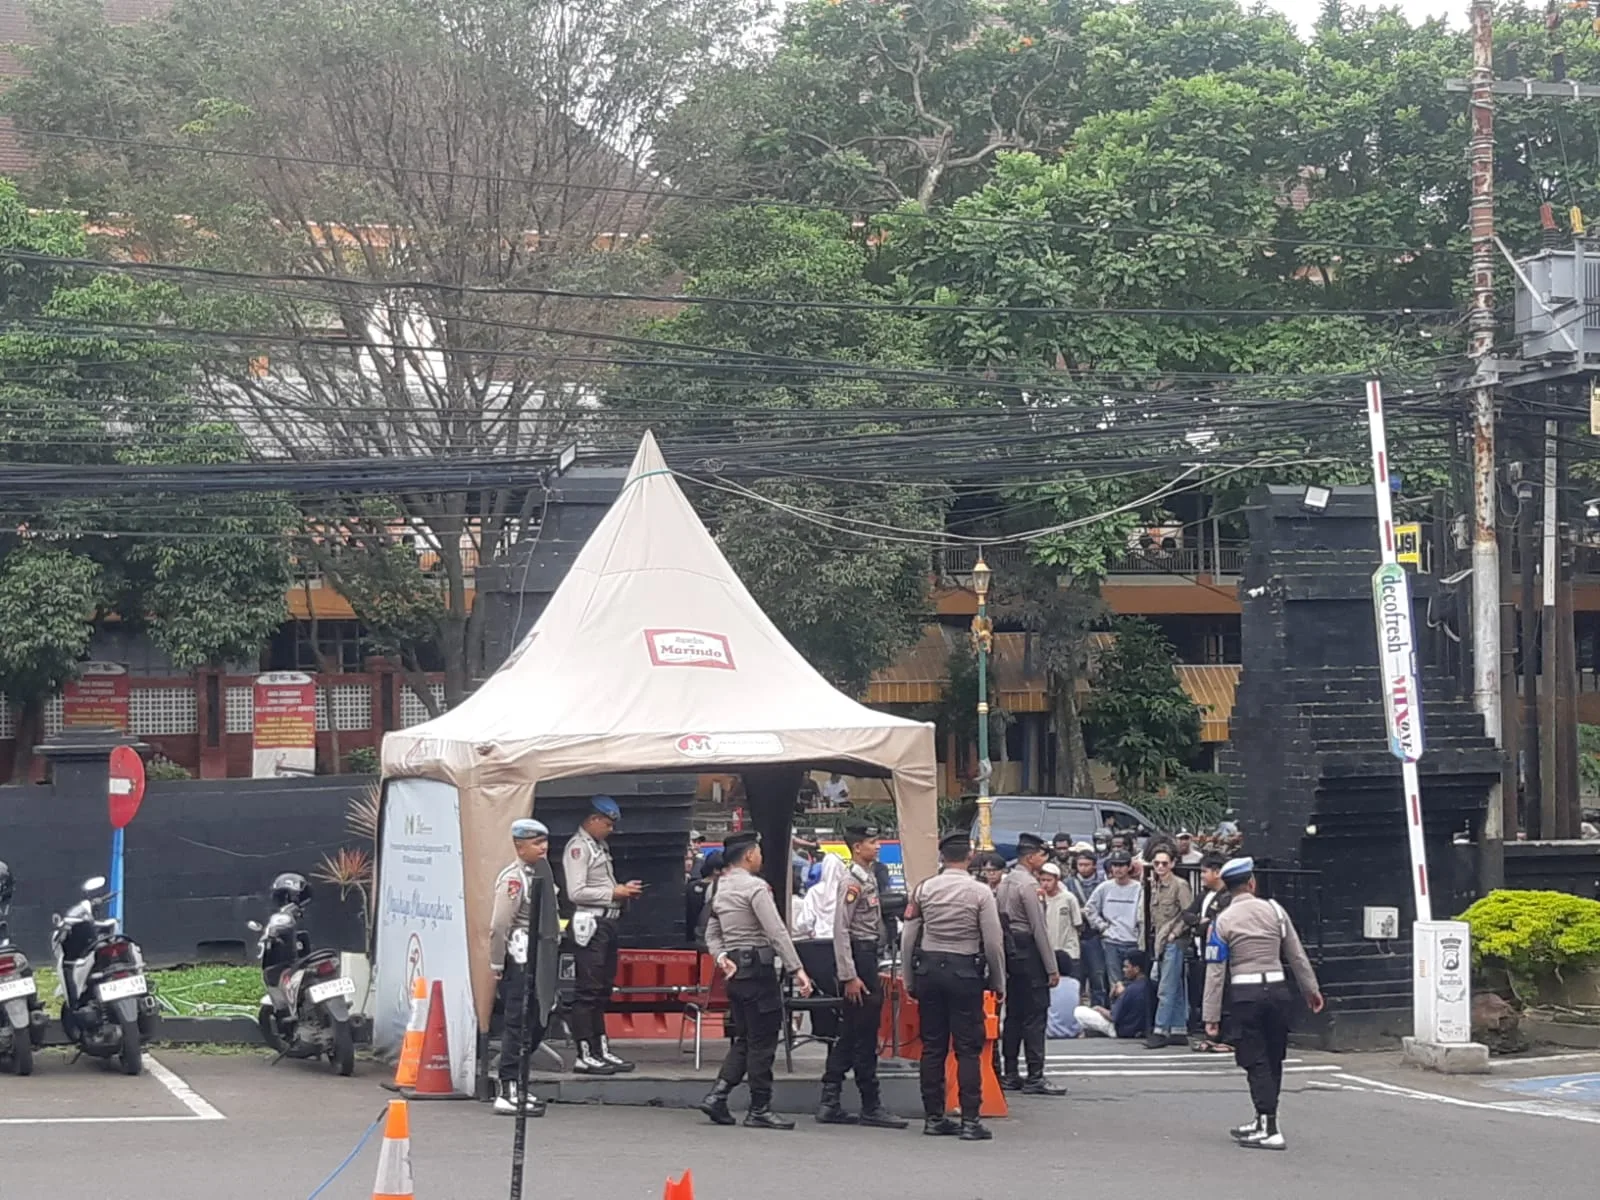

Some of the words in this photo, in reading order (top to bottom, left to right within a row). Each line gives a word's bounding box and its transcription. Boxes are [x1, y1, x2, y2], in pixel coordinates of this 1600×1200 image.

[1394, 531, 1417, 553] LISI
[1381, 575, 1409, 653] decofresh
[660, 644, 722, 658] Marindo
